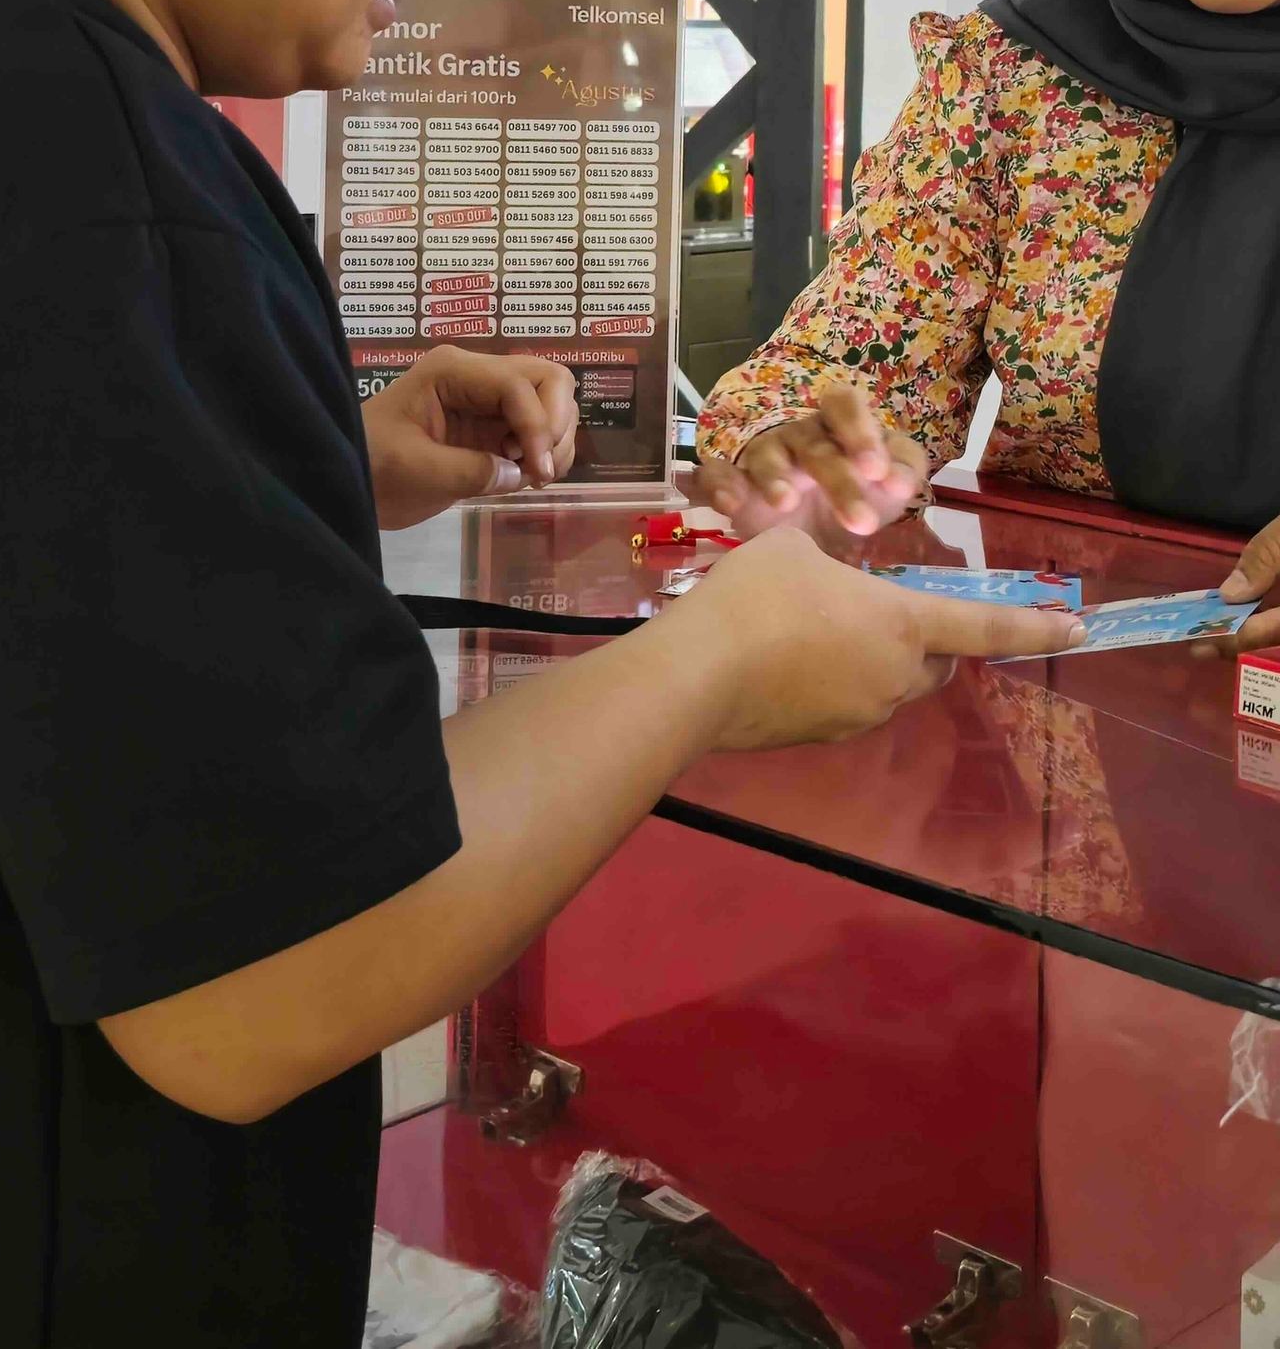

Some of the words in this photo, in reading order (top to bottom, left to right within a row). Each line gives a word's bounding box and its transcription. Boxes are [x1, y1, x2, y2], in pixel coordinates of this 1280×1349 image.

[568, 6, 664, 26] Telkomsel
[438, 53, 520, 77] Gratis
[342, 89, 387, 105] Paket
[390, 90, 433, 104] mulai
[436, 91, 467, 104] dari
[471, 91, 516, 105] 100rb
[561, 80, 655, 107] Agustus
[436, 279, 459, 293] SOLD
[462, 277, 485, 290] OUT
[580, 350, 625, 363] 150Ribu
[1243, 700, 1276, 718] HKM
